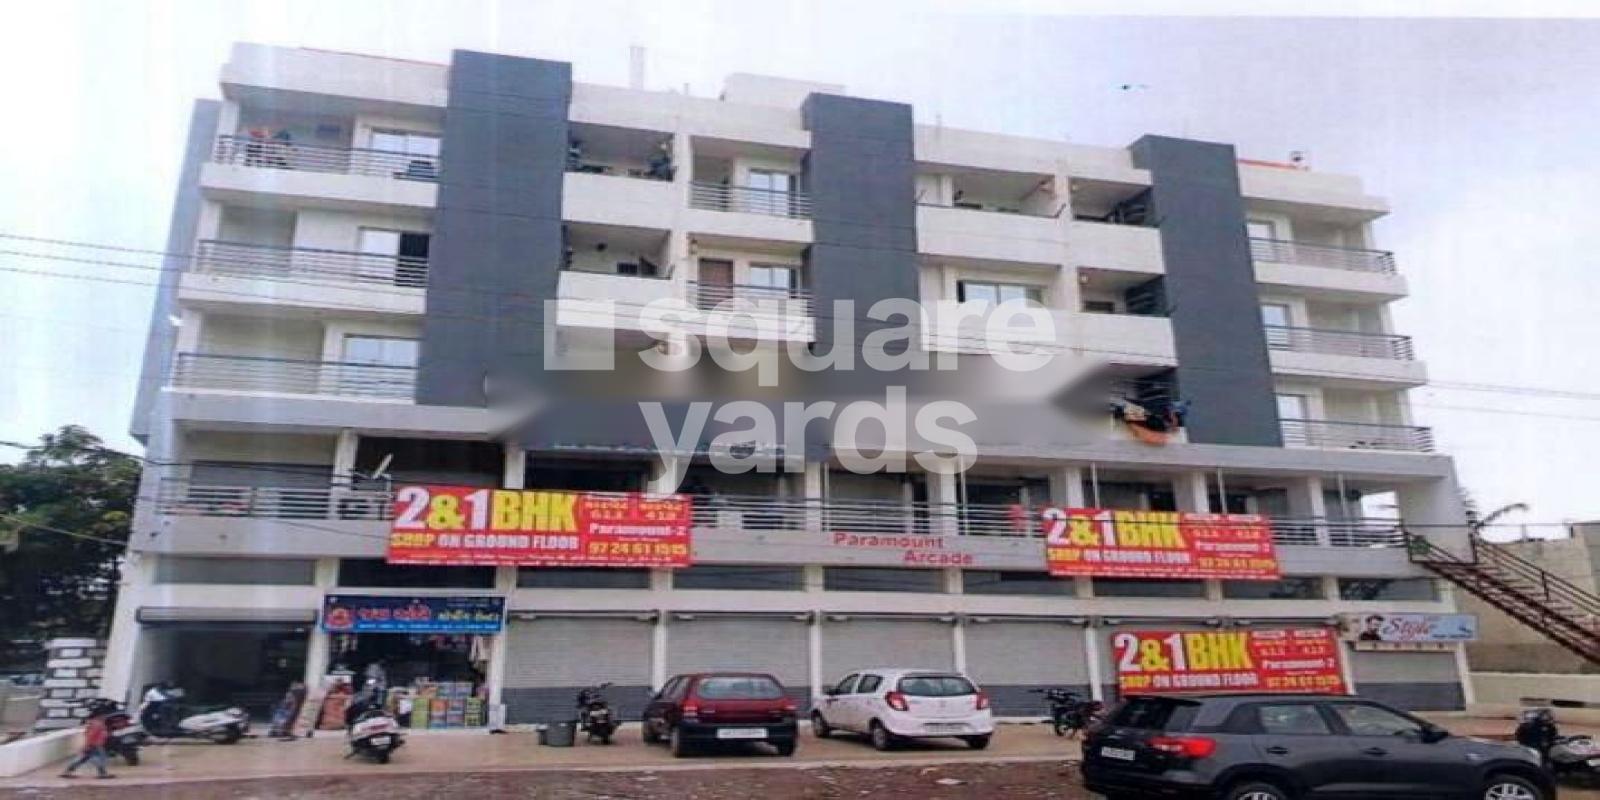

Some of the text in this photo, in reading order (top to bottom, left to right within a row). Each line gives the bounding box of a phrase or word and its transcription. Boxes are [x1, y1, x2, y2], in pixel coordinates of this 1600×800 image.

[391, 533, 580, 550] SHOP ON GROUND FLOOR
[833, 532, 944, 548] Paramount
[903, 549, 972, 564] Arcade
